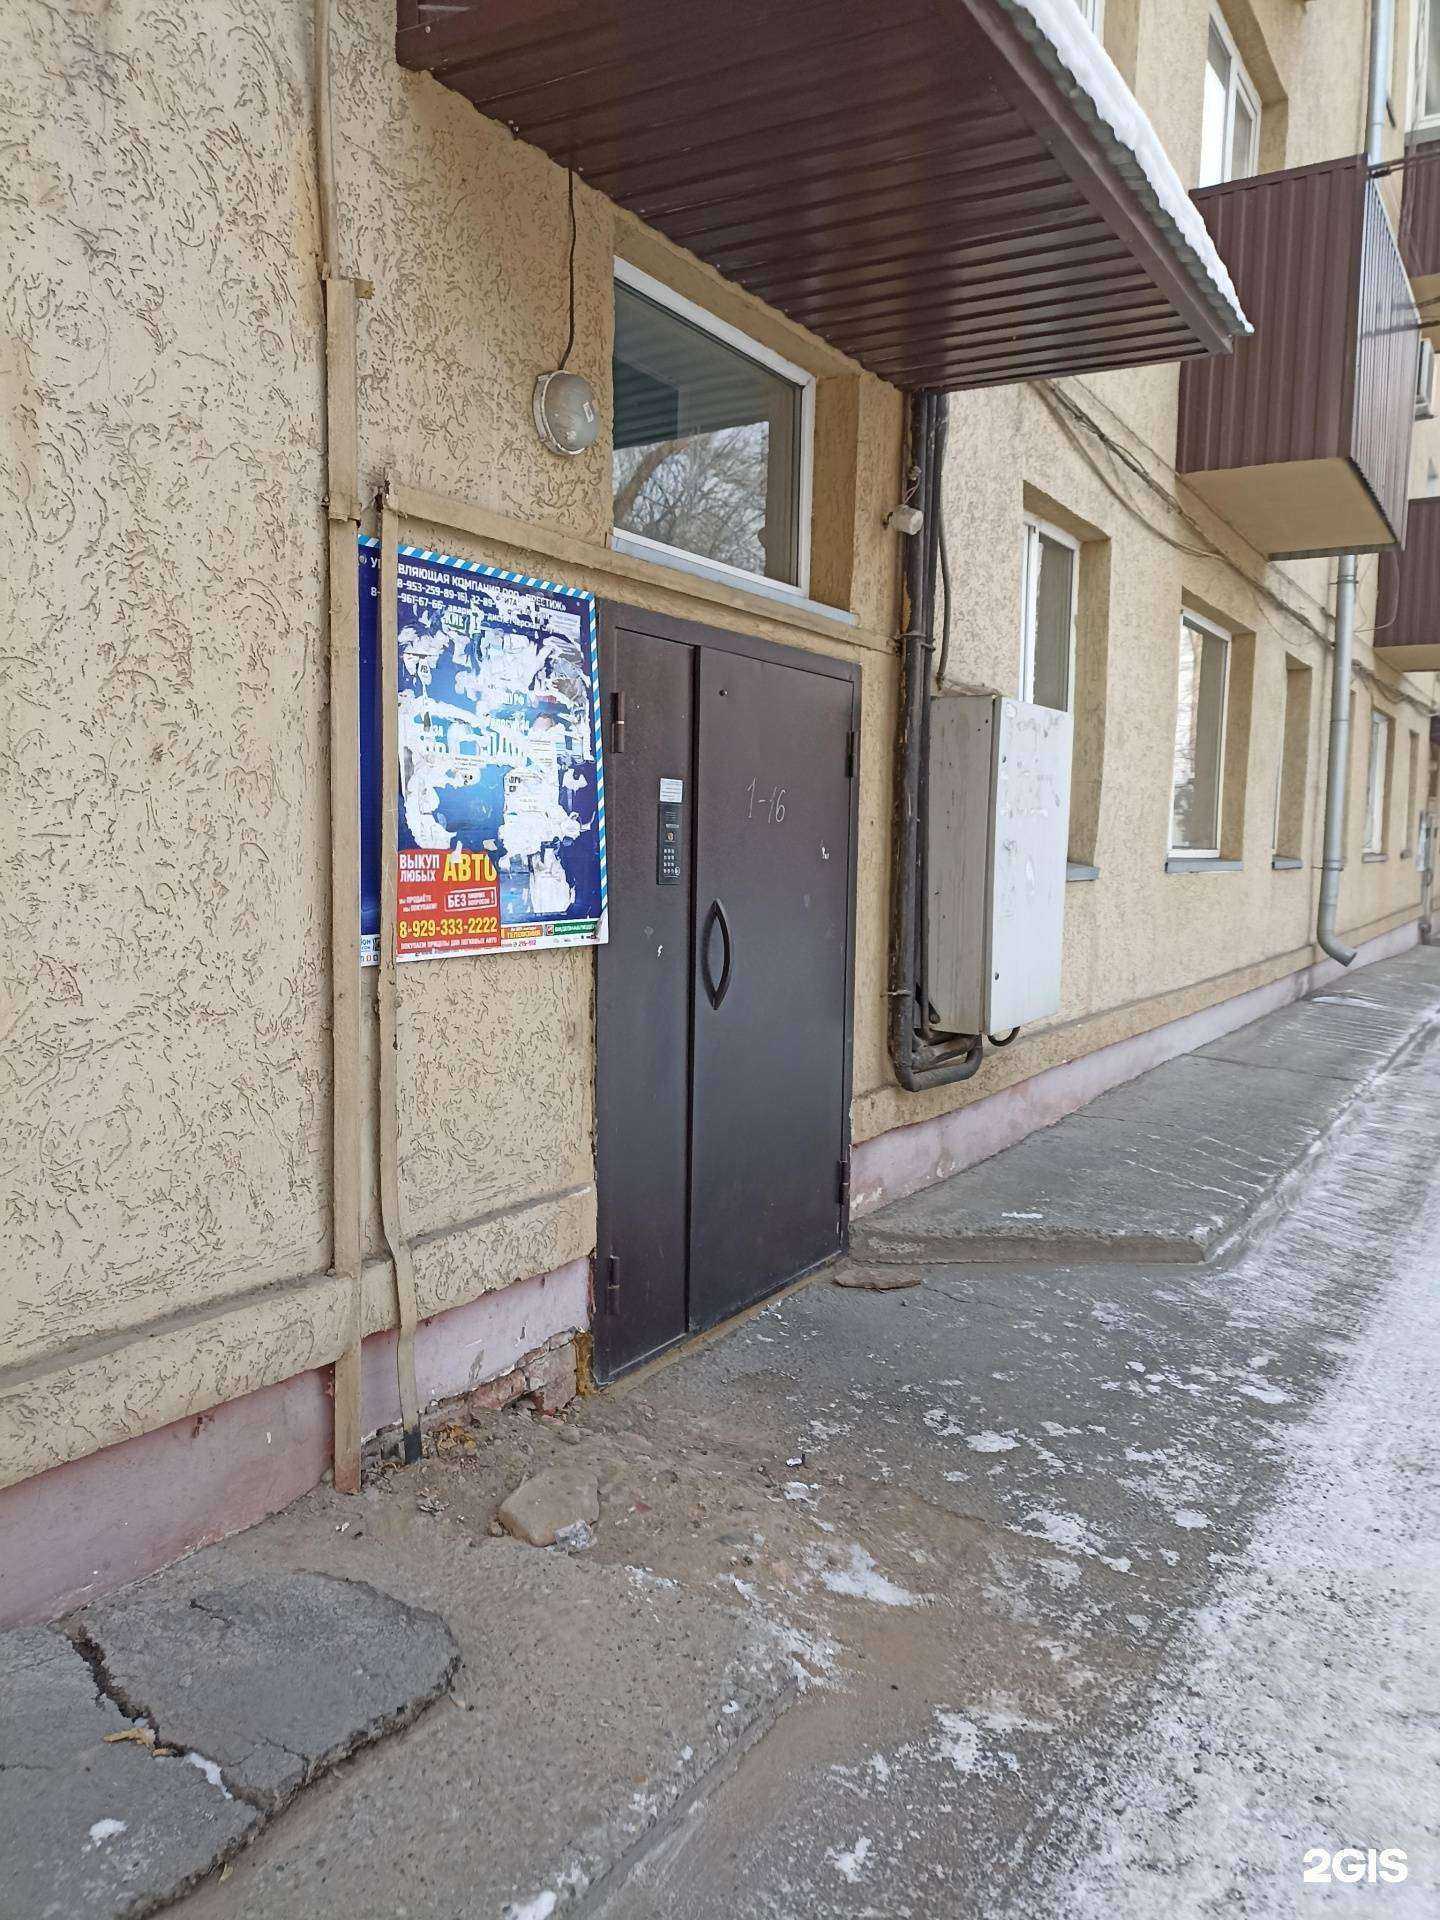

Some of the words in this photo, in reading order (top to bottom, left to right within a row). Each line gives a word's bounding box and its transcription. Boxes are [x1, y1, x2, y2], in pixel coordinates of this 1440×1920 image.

[745, 776, 786, 824] 1-16
[400, 854, 440, 870] ВЫКУП
[443, 853, 497, 882] АВТО
[400, 870, 436, 883] ЛЮБЫХ
[447, 894, 467, 908] БЕЗ
[399, 917, 498, 939] 8-929-333-2222
